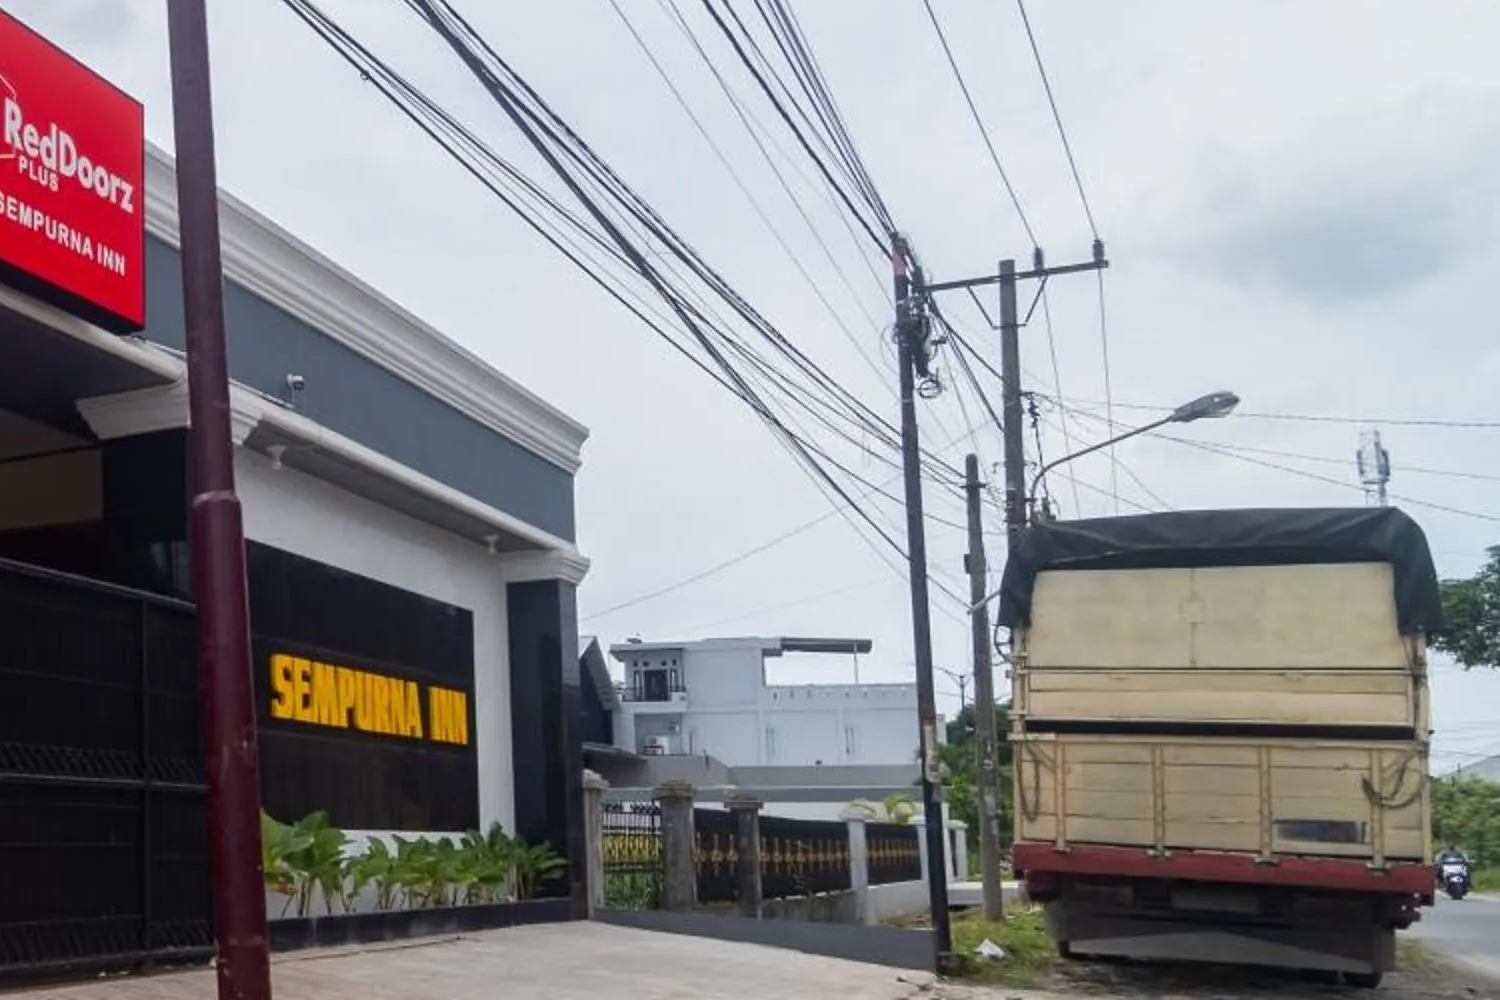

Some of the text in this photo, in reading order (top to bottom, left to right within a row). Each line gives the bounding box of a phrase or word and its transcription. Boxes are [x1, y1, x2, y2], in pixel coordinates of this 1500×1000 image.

[4, 98, 133, 213] RedDoorz
[19, 156, 59, 192] PLUS
[97, 243, 125, 276] INN
[270, 653, 468, 745] SEMPURNA INN
